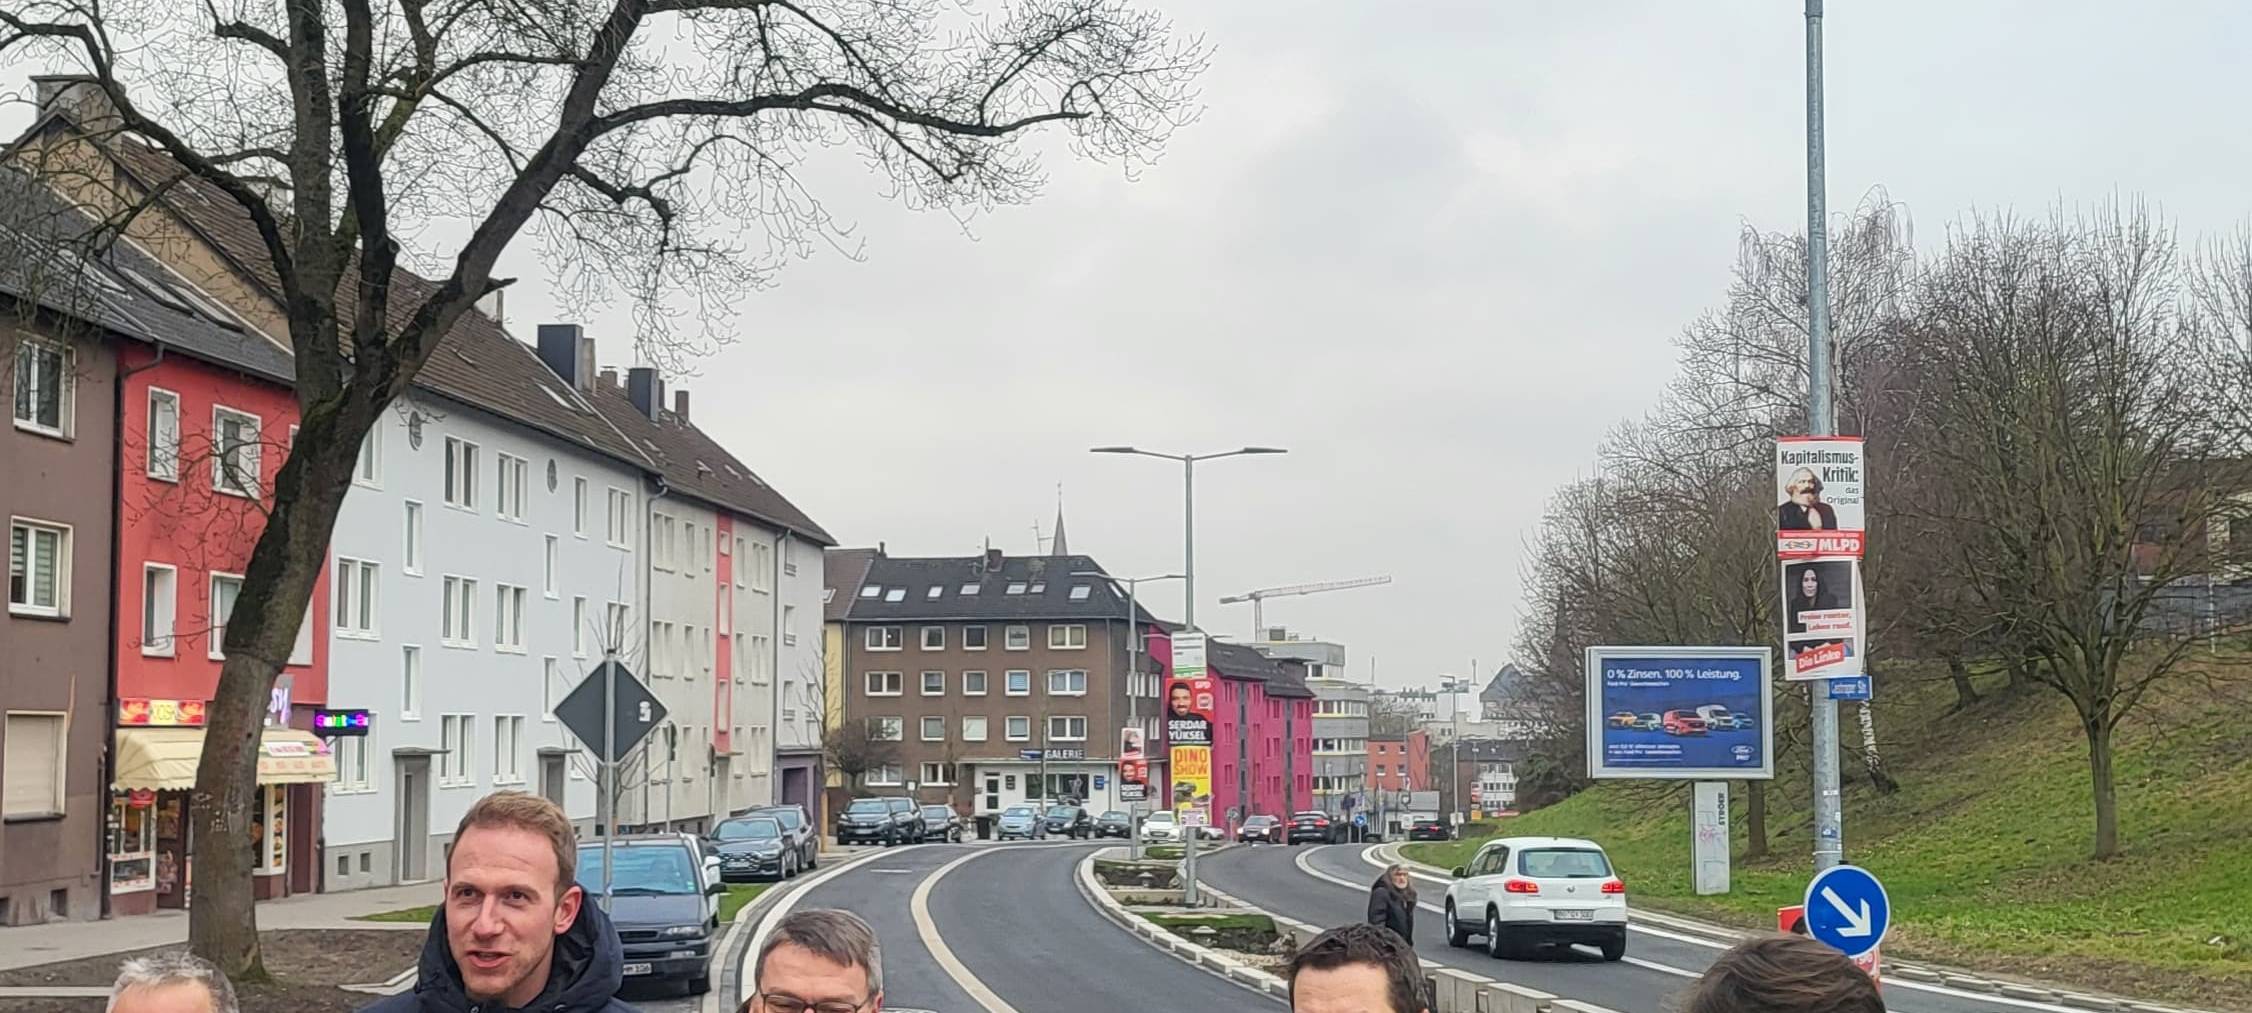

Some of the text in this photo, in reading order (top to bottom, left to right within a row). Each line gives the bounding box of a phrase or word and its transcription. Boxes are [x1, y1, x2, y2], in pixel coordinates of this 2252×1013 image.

[1781, 450, 1859, 466] Kapitalismus-
[1823, 467, 1859, 483] Kritik:
[1821, 539, 1860, 552] MLPD
[1799, 655, 1813, 669] Die
[1607, 668, 1742, 681] 0 % Zinsen. 100 % Leistung.
[1168, 720, 1208, 730] SERDAR
[1044, 749, 1083, 759] GALERIE
[1175, 749, 1207, 763] DINO
[1174, 763, 1208, 775] SHOW
